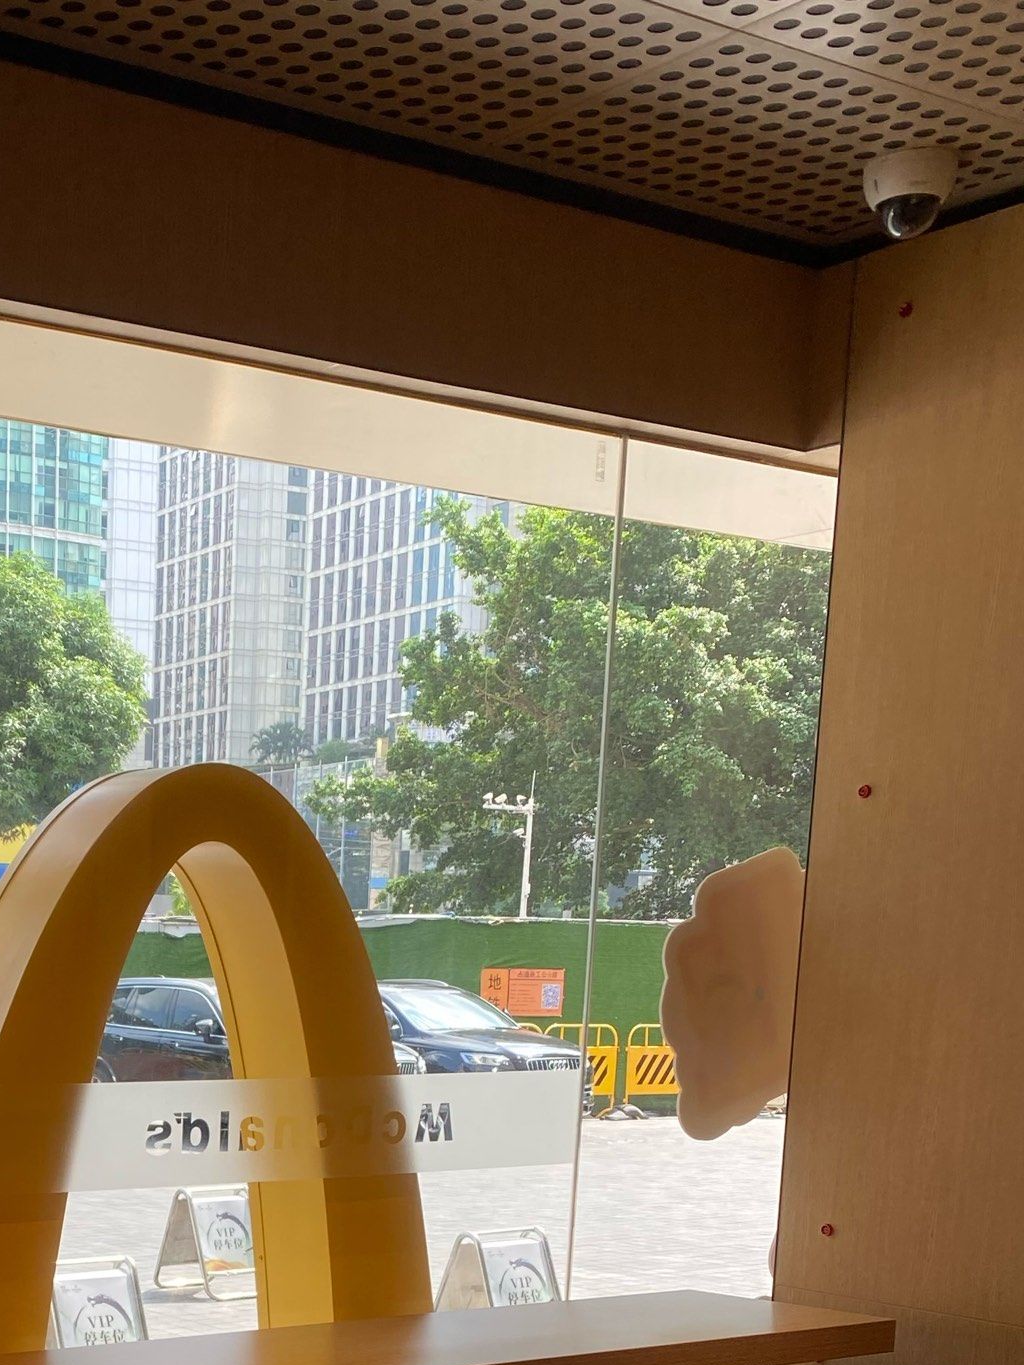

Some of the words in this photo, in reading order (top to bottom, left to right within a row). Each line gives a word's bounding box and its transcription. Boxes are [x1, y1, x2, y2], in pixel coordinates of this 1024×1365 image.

[216, 1227, 235, 1237] VIP
[511, 1276, 532, 1289] VIP
[88, 1315, 114, 1328] VIP
